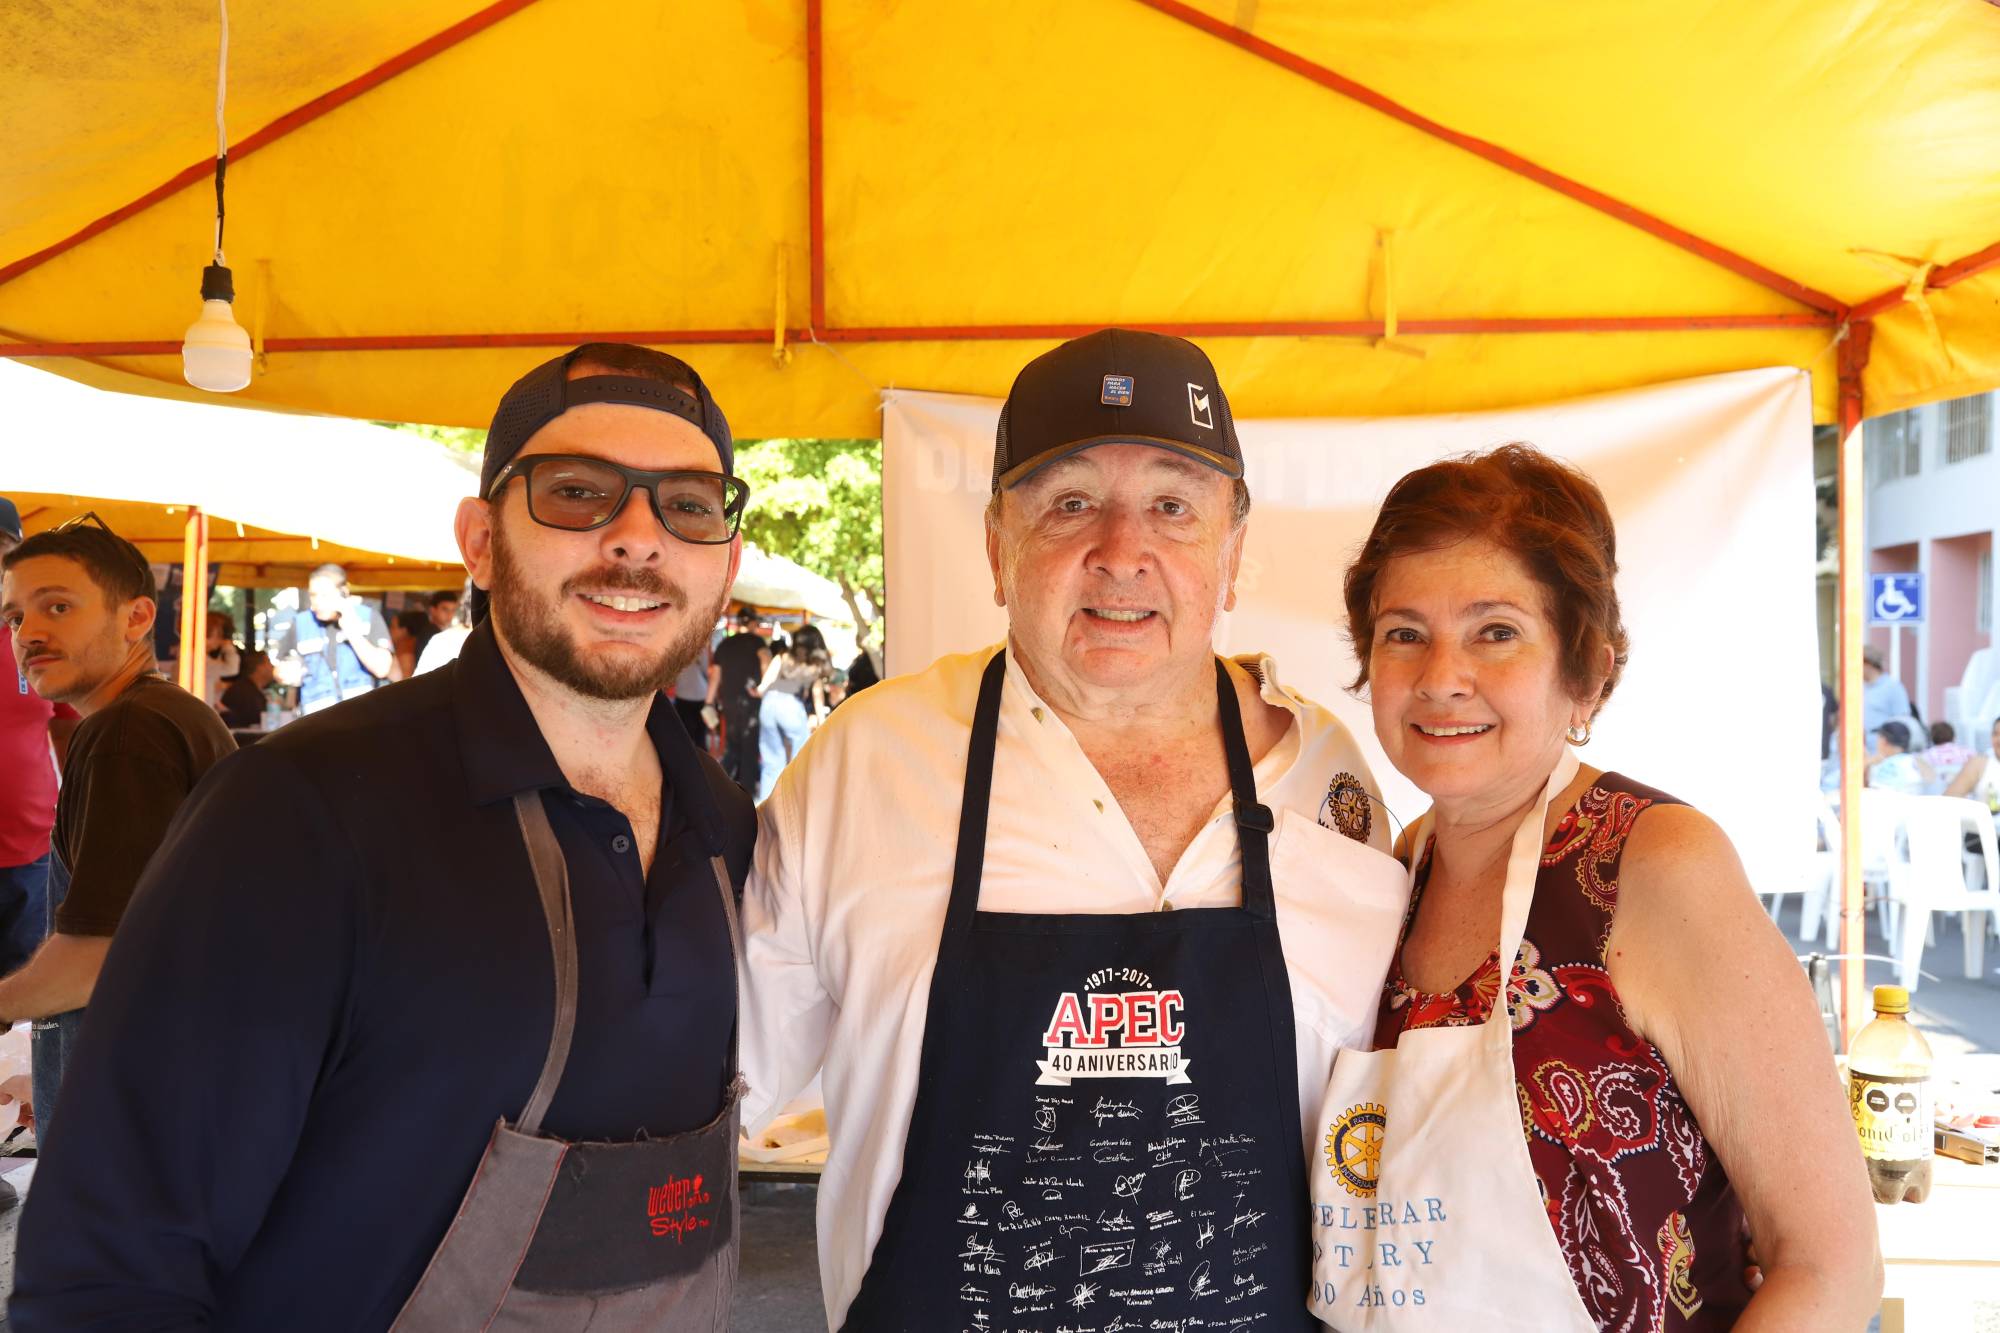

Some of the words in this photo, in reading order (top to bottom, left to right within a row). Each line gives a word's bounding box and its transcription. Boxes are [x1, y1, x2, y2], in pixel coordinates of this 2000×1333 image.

[1043, 990, 1185, 1048] APEC
[1052, 1054, 1072, 1072] 40
[1076, 1052, 1178, 1072] ANIVERSARIO
[1356, 1284, 1426, 1307] Años
